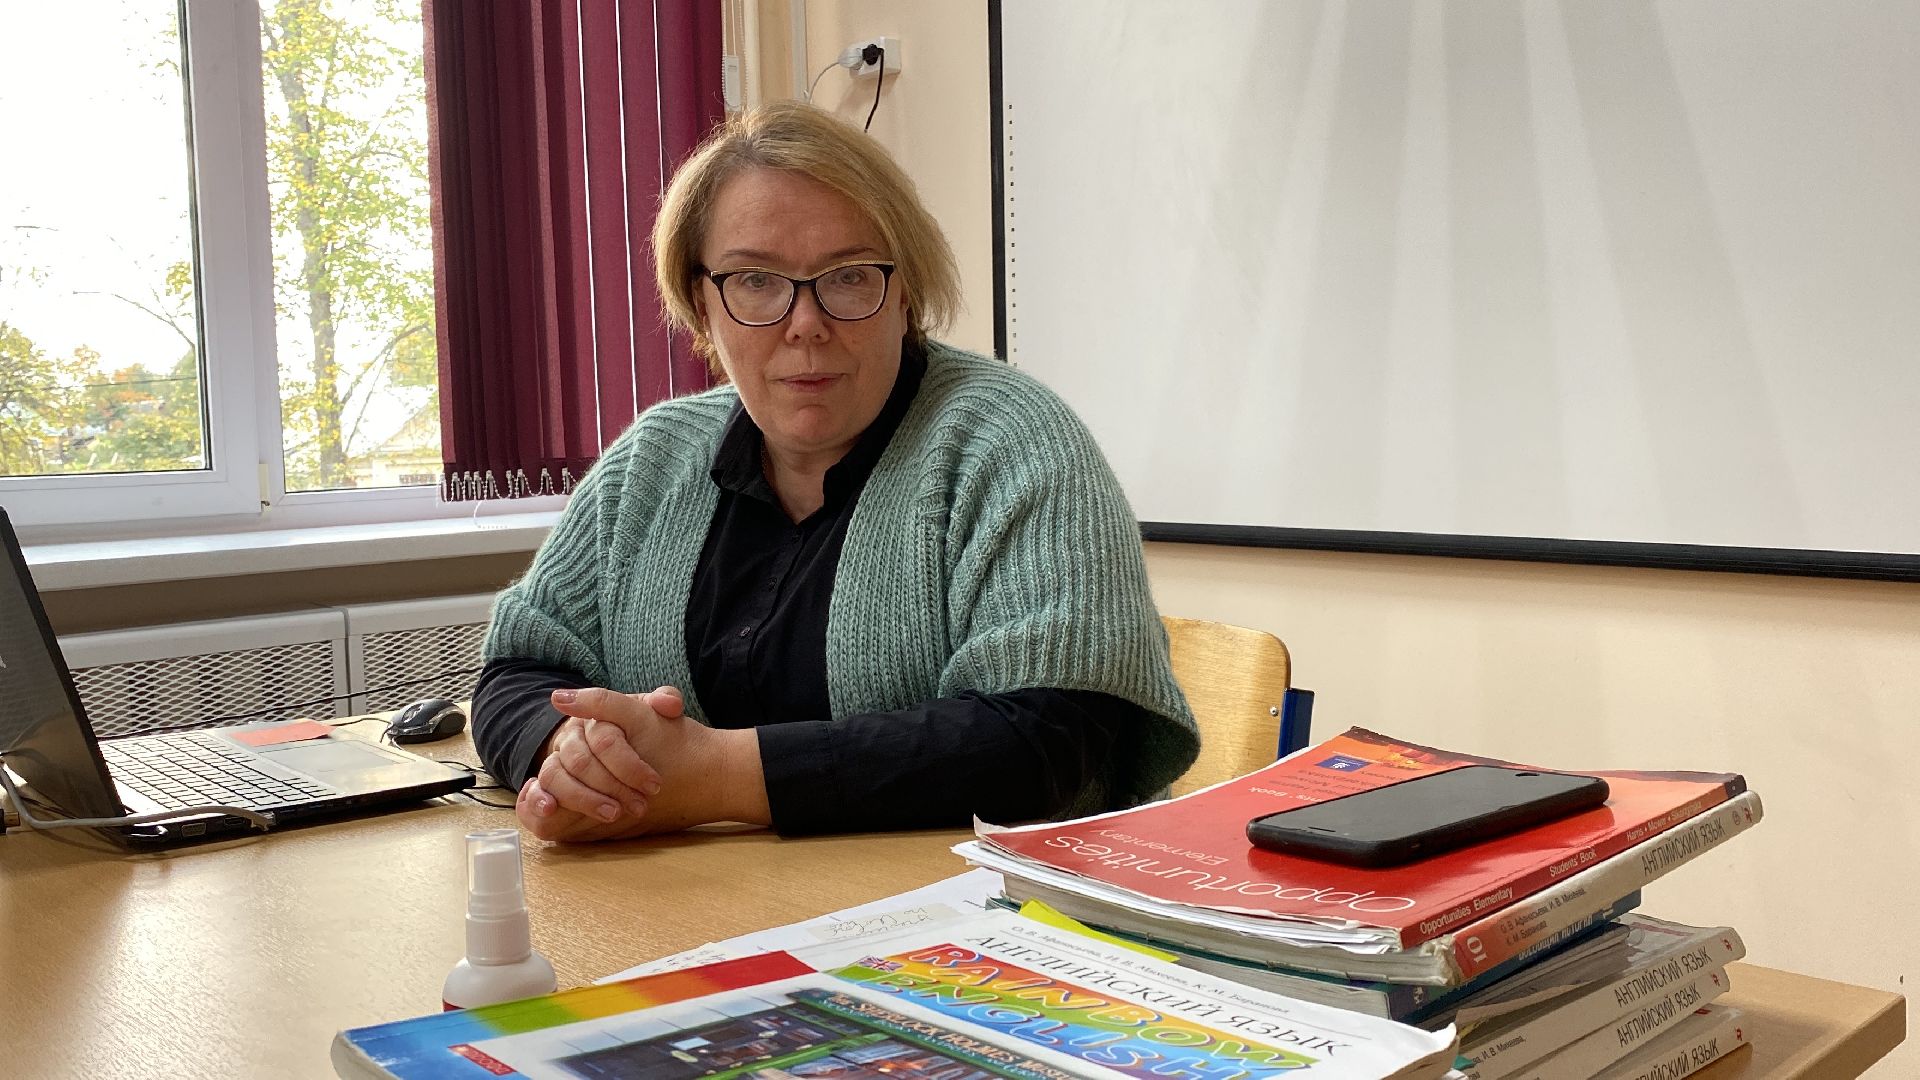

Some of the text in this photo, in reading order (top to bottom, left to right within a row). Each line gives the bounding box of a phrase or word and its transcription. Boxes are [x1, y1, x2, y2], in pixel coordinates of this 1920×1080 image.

[1045, 835, 1416, 913] Opportunities
[1093, 828, 1229, 867] Elementary
[1579, 849, 1597, 864] Book
[1641, 817, 1726, 876] АНГЛИЙСКИЙ ЯЗЫК
[1419, 886, 1513, 935] Opportunities Elementary
[1467, 936, 1488, 964] 10
[1613, 946, 1713, 1008] АНГЛИЙСКИЙ ЯЗЫК
[855, 971, 1248, 1080] ENGLISH
[908, 944, 1313, 1070] RAINBOW
[964, 935, 1353, 1057] АНГЛИЙСКИЙ ЯЗЫК
[1616, 983, 1702, 1048] АНГЛИЙСКИЙ ЯЗЫК
[1691, 1037, 1720, 1067] ЯЗЫК
